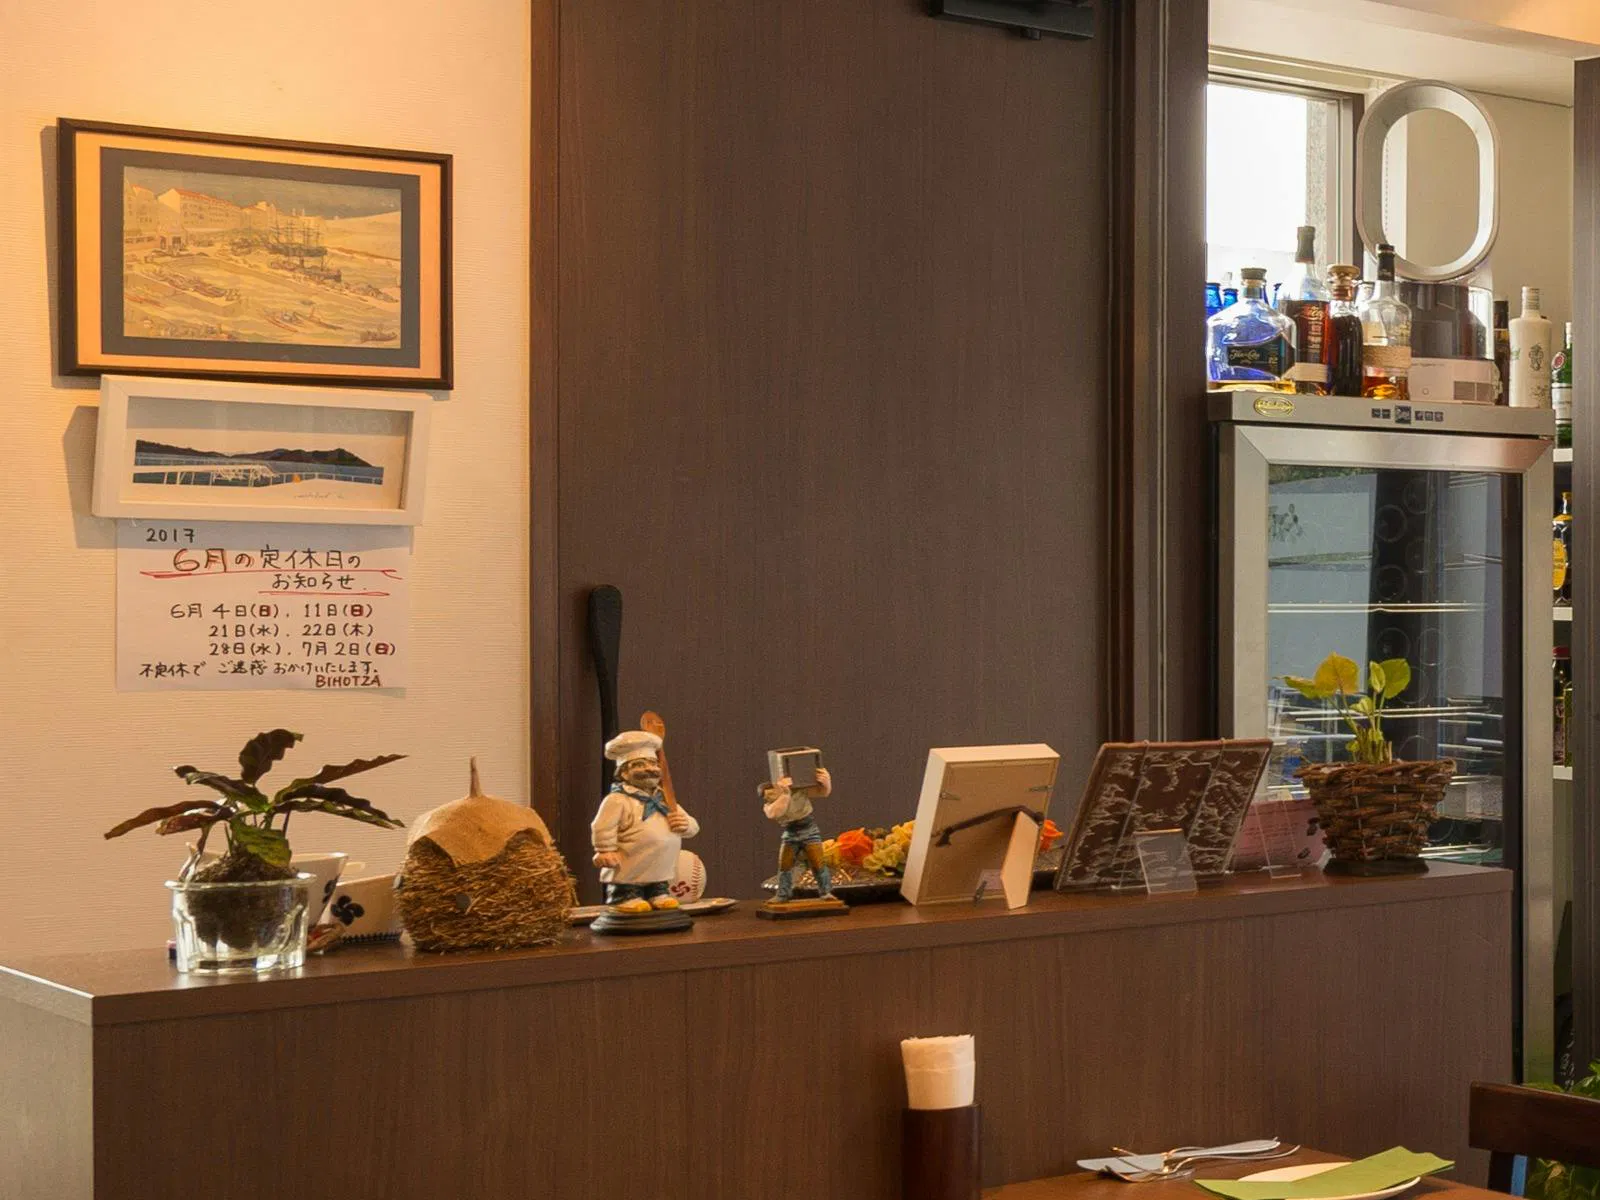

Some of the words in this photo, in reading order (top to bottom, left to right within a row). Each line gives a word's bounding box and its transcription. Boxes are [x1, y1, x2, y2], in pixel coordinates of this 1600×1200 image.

[145, 528, 195, 543] 2017
[173, 544, 361, 573] 6月の定休日の
[315, 674, 381, 688] BIHOTZA
